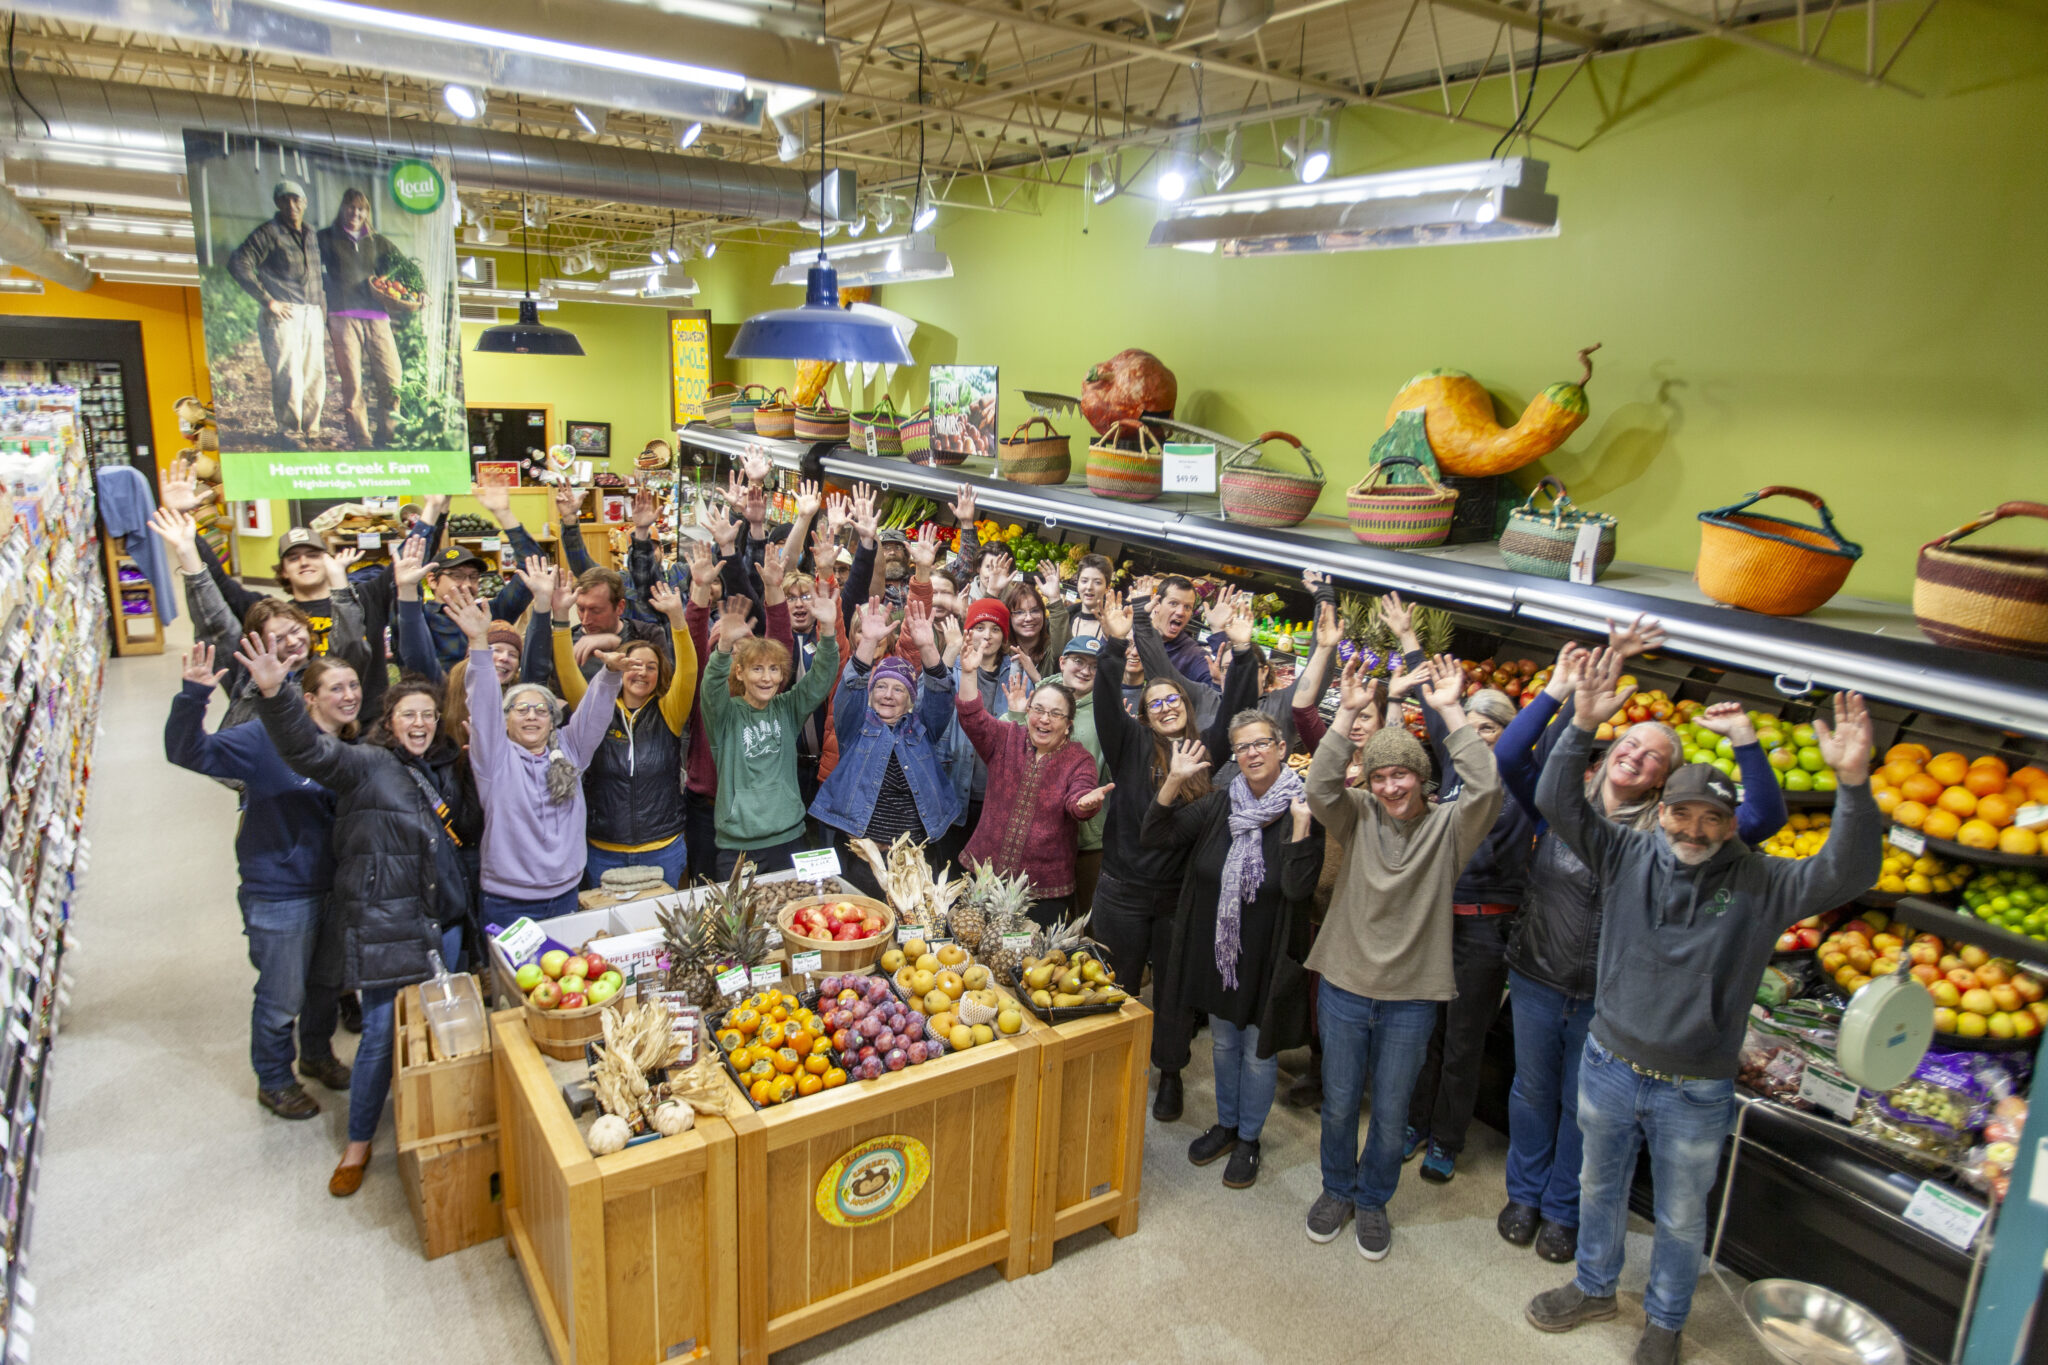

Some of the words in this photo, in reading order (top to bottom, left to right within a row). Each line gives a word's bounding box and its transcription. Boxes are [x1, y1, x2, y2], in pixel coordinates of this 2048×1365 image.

[397, 177, 434, 198] Local
[678, 346, 706, 370] WHOLE
[679, 377, 710, 401] FOOD
[269, 463, 332, 476] Hermit
[335, 461, 384, 475] Creek
[388, 461, 430, 474] Farm
[481, 466, 517, 474] PRODUCE
[293, 479, 357, 490] Highbridge,
[358, 478, 411, 487] Wisconsin
[633, 949, 660, 960] PEELER
